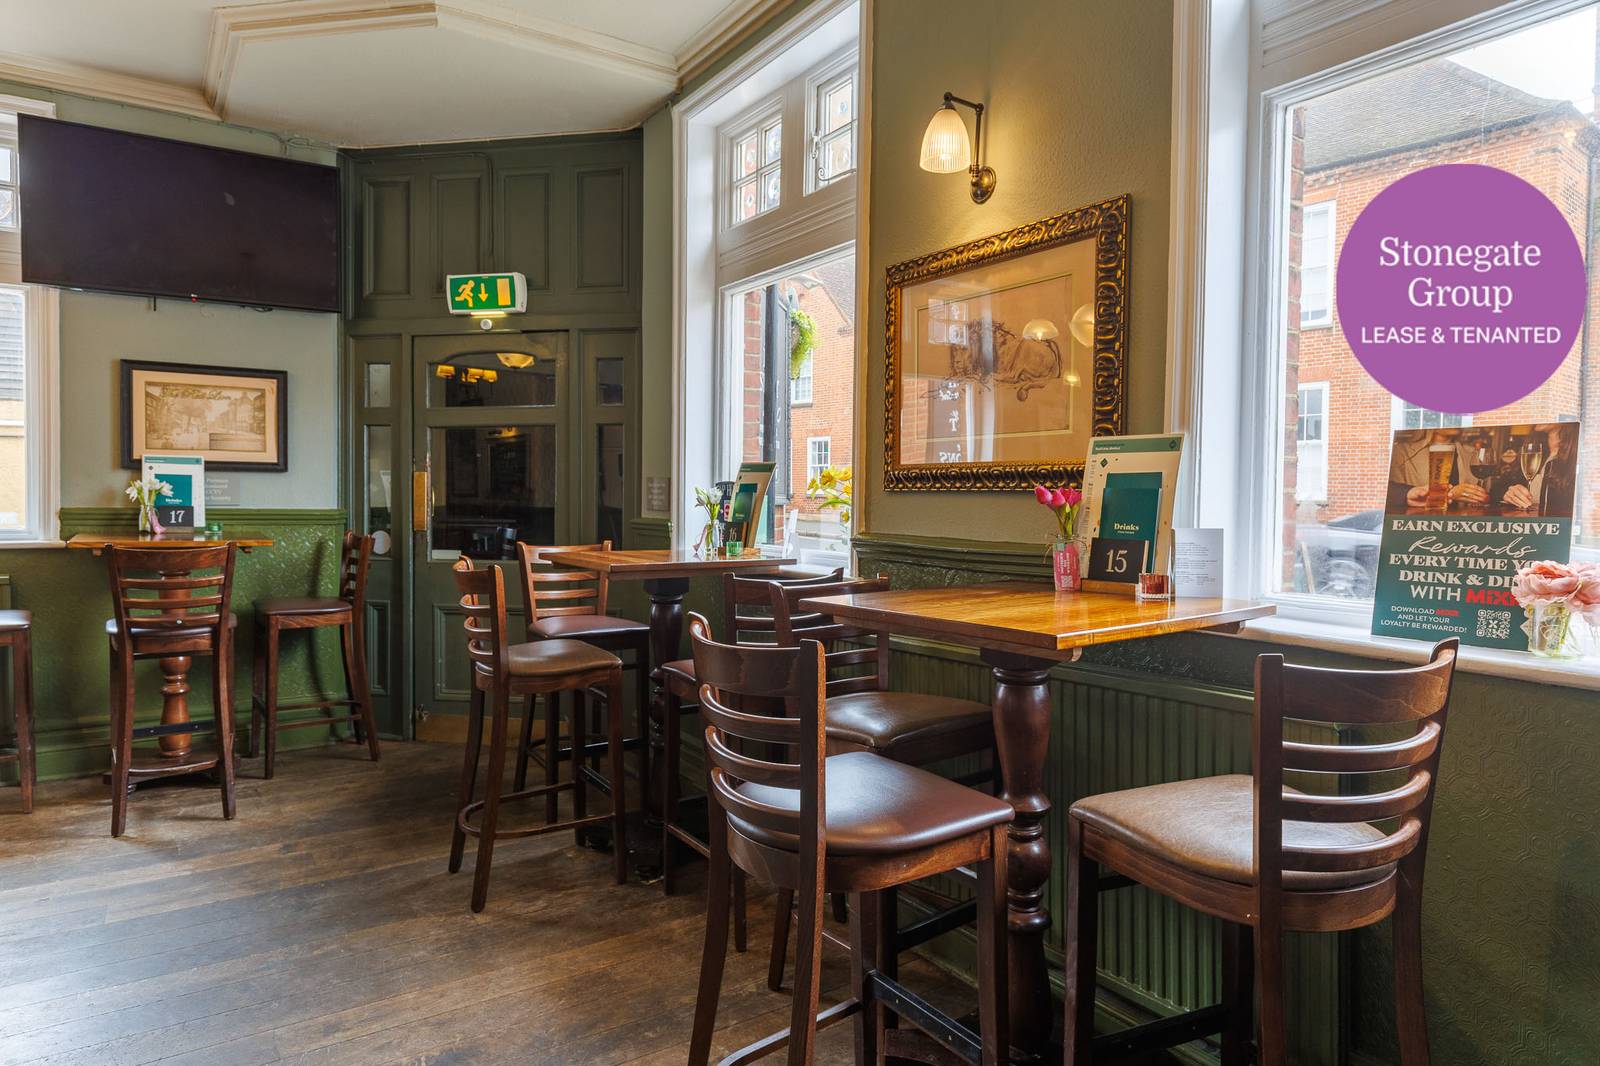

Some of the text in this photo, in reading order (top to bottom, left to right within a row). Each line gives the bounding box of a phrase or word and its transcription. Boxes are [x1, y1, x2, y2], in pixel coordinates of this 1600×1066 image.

[170, 510, 185, 523] 17
[1114, 522, 1140, 531] Drinks
[1392, 520, 1560, 535] EARN EXCLUSIVE
[1409, 536, 1536, 559] Rewards
[1105, 549, 1128, 573] 15
[1389, 553, 1452, 567] EVERY
[1454, 556, 1508, 570] TIME
[1399, 570, 1462, 585] DRINK
[1466, 574, 1484, 586] &
[1410, 585, 1461, 601] WITH
[1391, 606, 1435, 615] DOWNLOAD
[1422, 624, 1467, 633] REWARDED!
